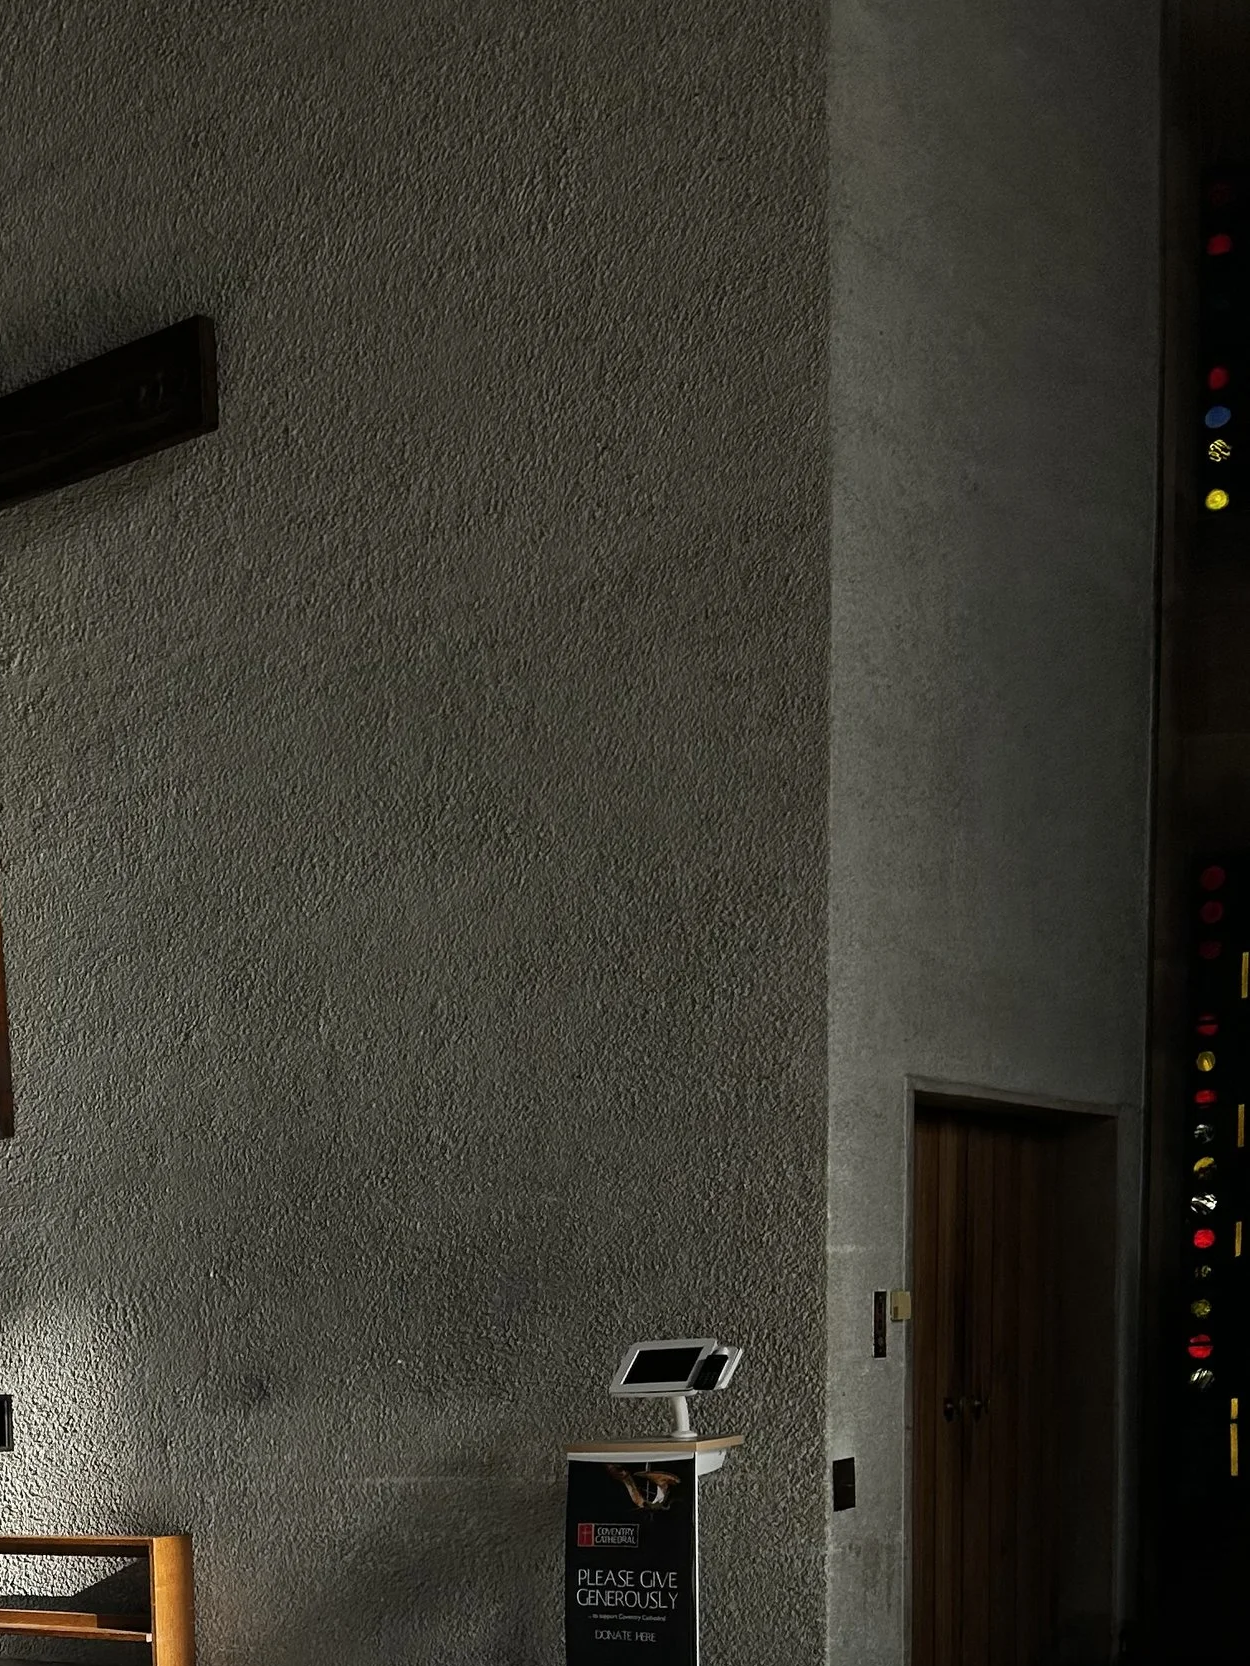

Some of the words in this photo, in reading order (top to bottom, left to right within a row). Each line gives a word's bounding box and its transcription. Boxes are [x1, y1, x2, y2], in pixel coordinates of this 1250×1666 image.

[597, 1526, 635, 1536] COVENTRY
[594, 1535, 637, 1545] CATHEDRAL
[578, 1568, 635, 1588] PLEASE
[640, 1570, 678, 1589] GIVE
[576, 1588, 679, 1610] GENEROUSLY
[594, 1629, 632, 1642] DONATE
[636, 1632, 657, 1643] HERE
